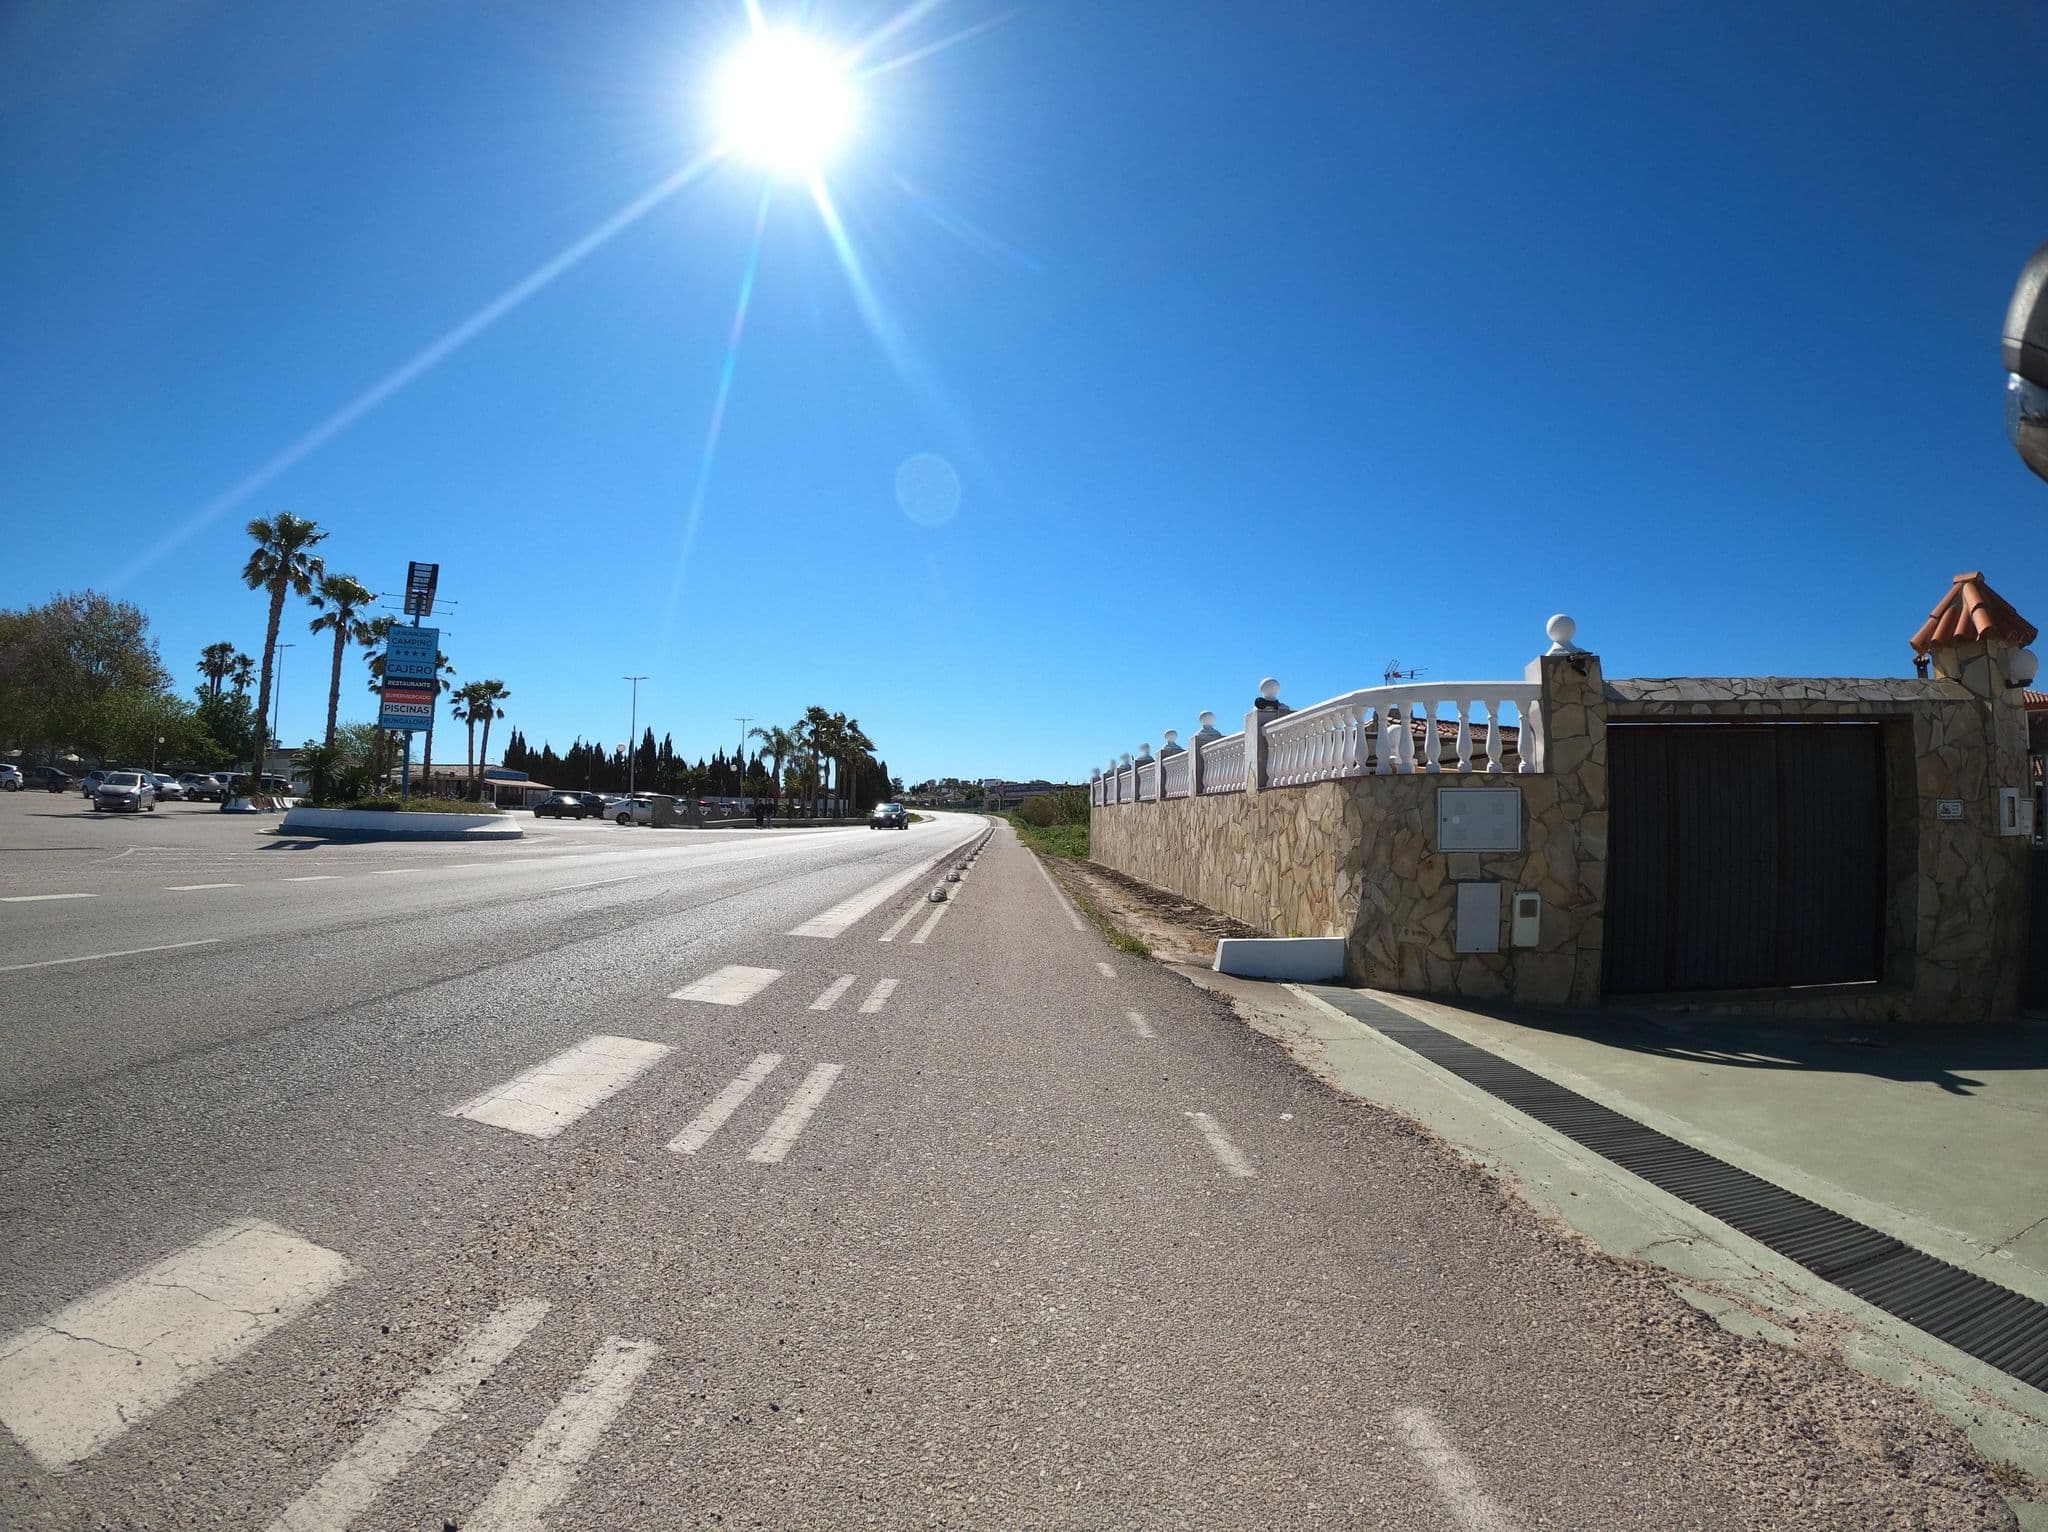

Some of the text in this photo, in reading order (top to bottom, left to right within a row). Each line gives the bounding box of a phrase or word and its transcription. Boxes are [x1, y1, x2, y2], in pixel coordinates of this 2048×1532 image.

[388, 664, 432, 675] CAJERO
[387, 680, 431, 688] RESTAURANTE
[384, 704, 430, 714] PISCINAS
